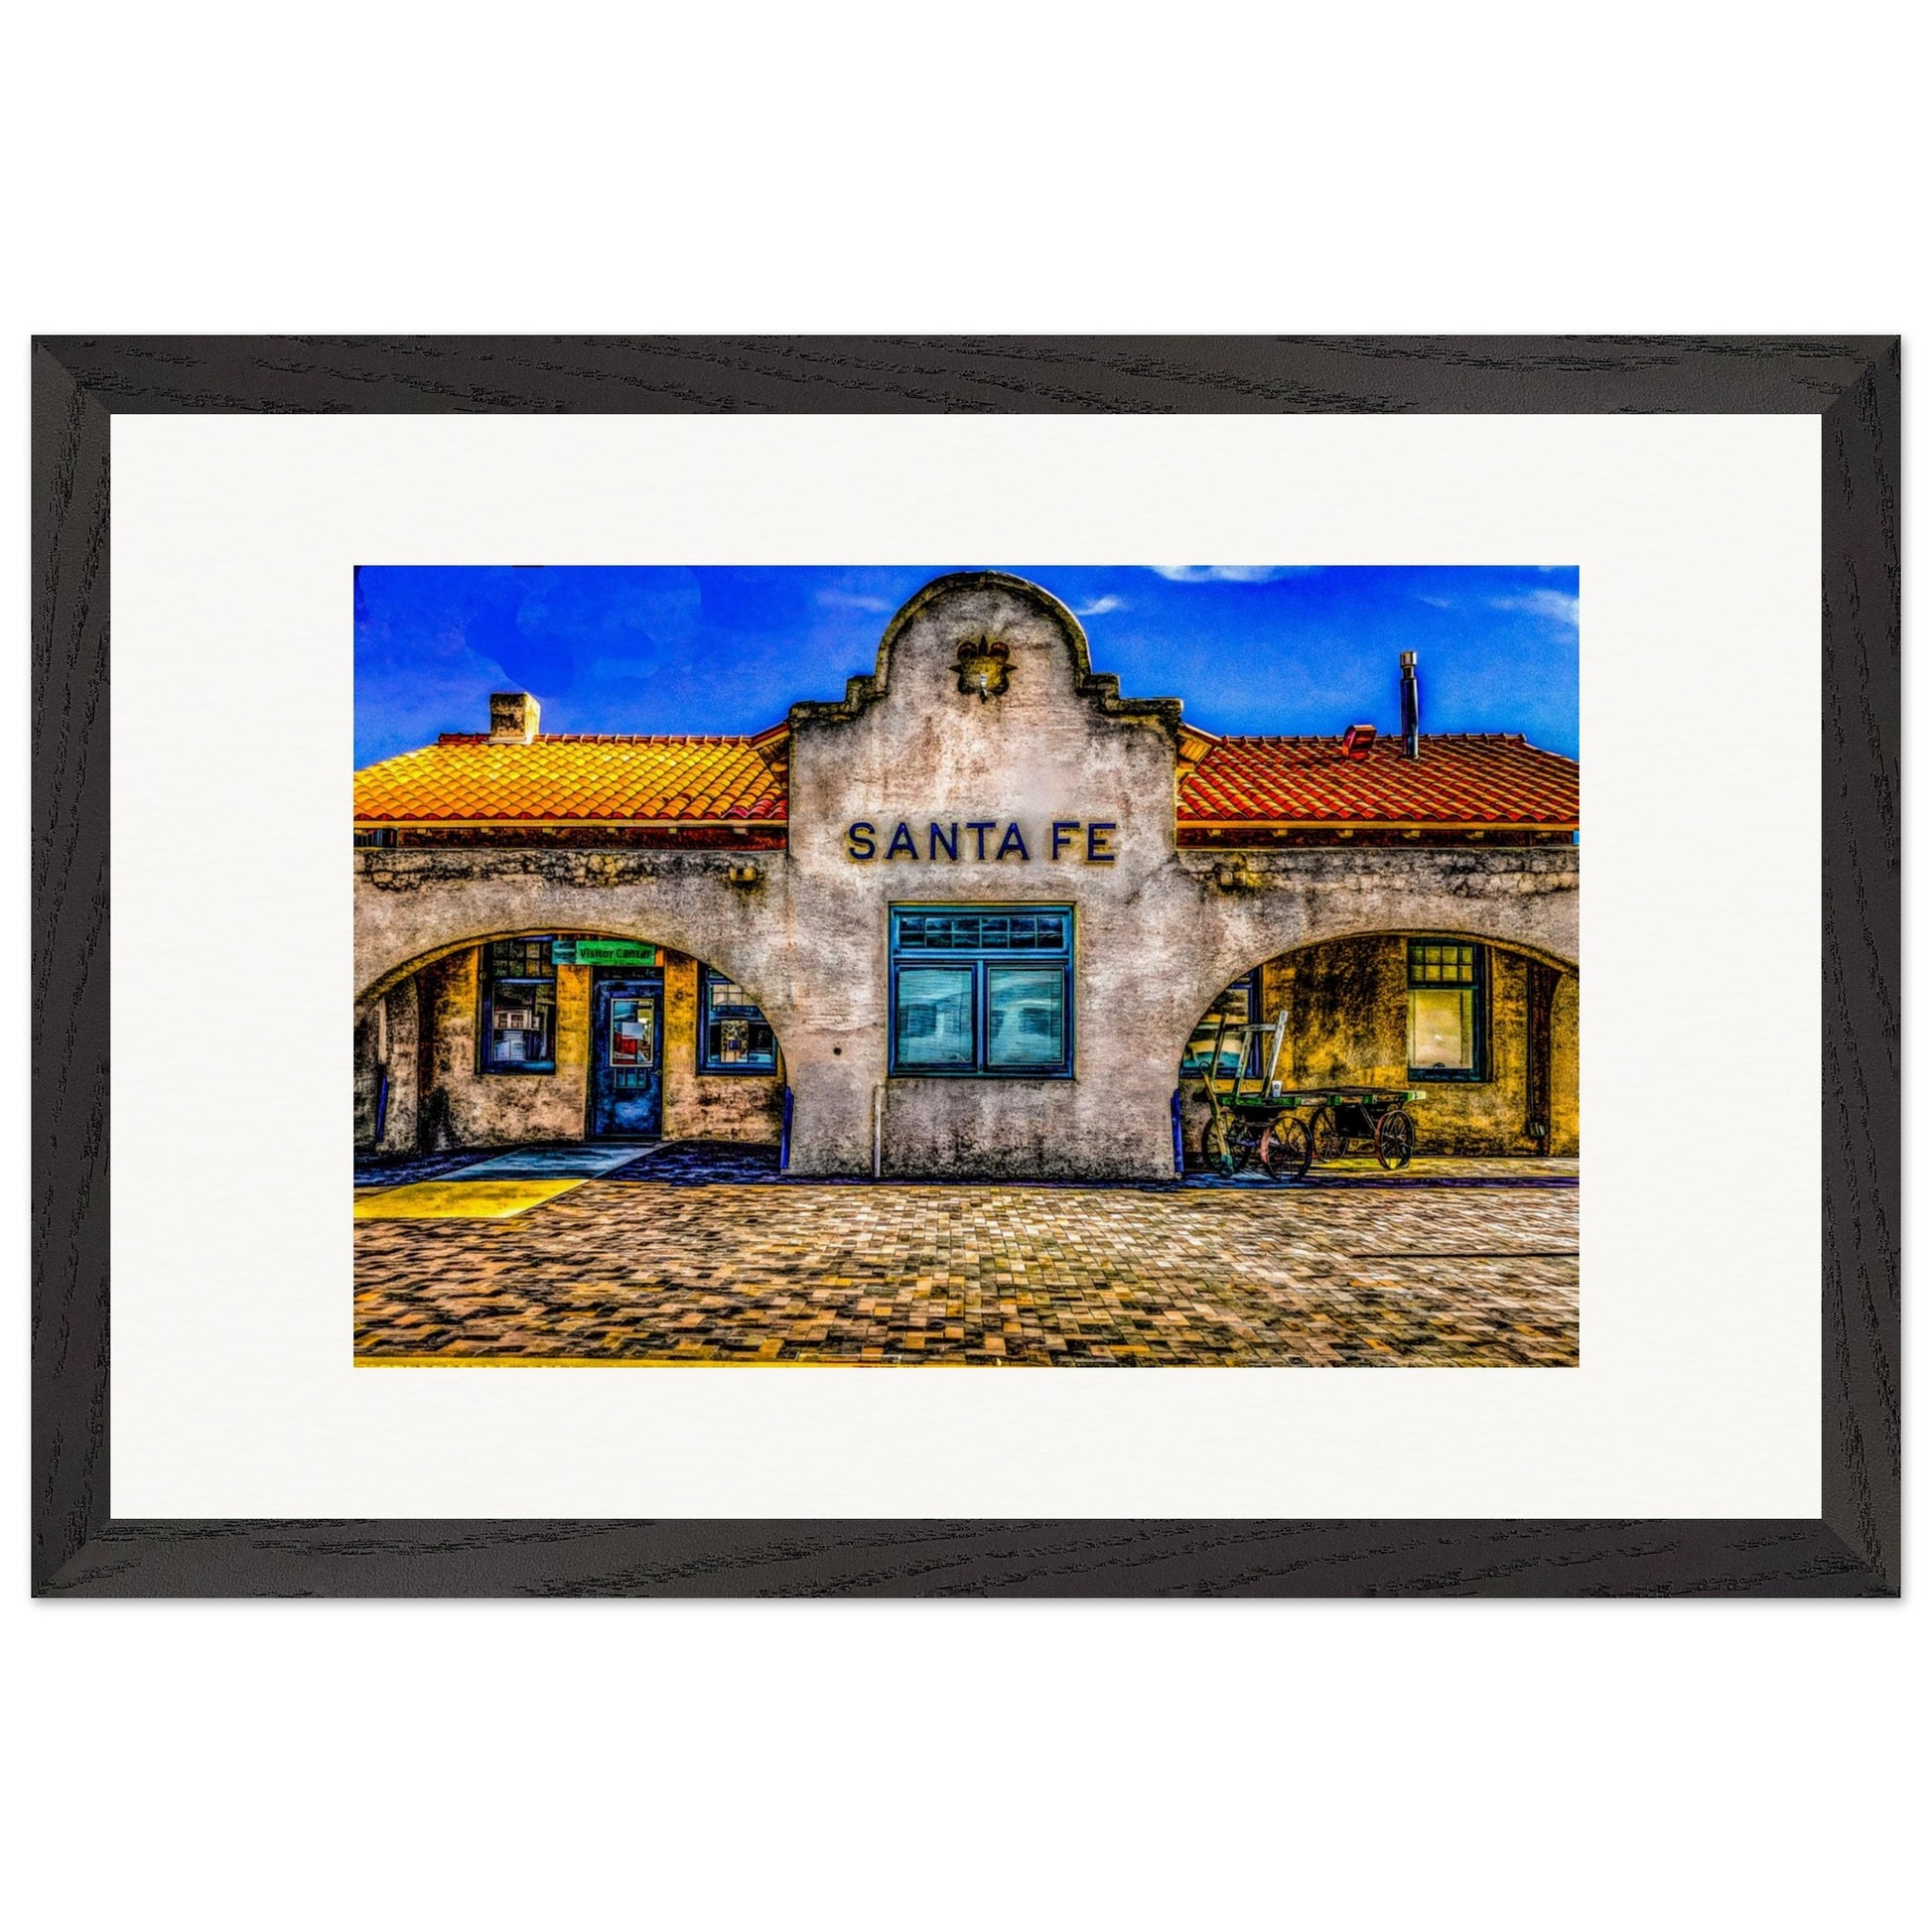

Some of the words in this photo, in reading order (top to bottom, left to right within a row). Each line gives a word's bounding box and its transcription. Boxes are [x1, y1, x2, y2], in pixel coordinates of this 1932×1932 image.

[848, 821, 1031, 861] SANTA
[1051, 821, 1117, 862] FE
[580, 948, 614, 959] Visitor
